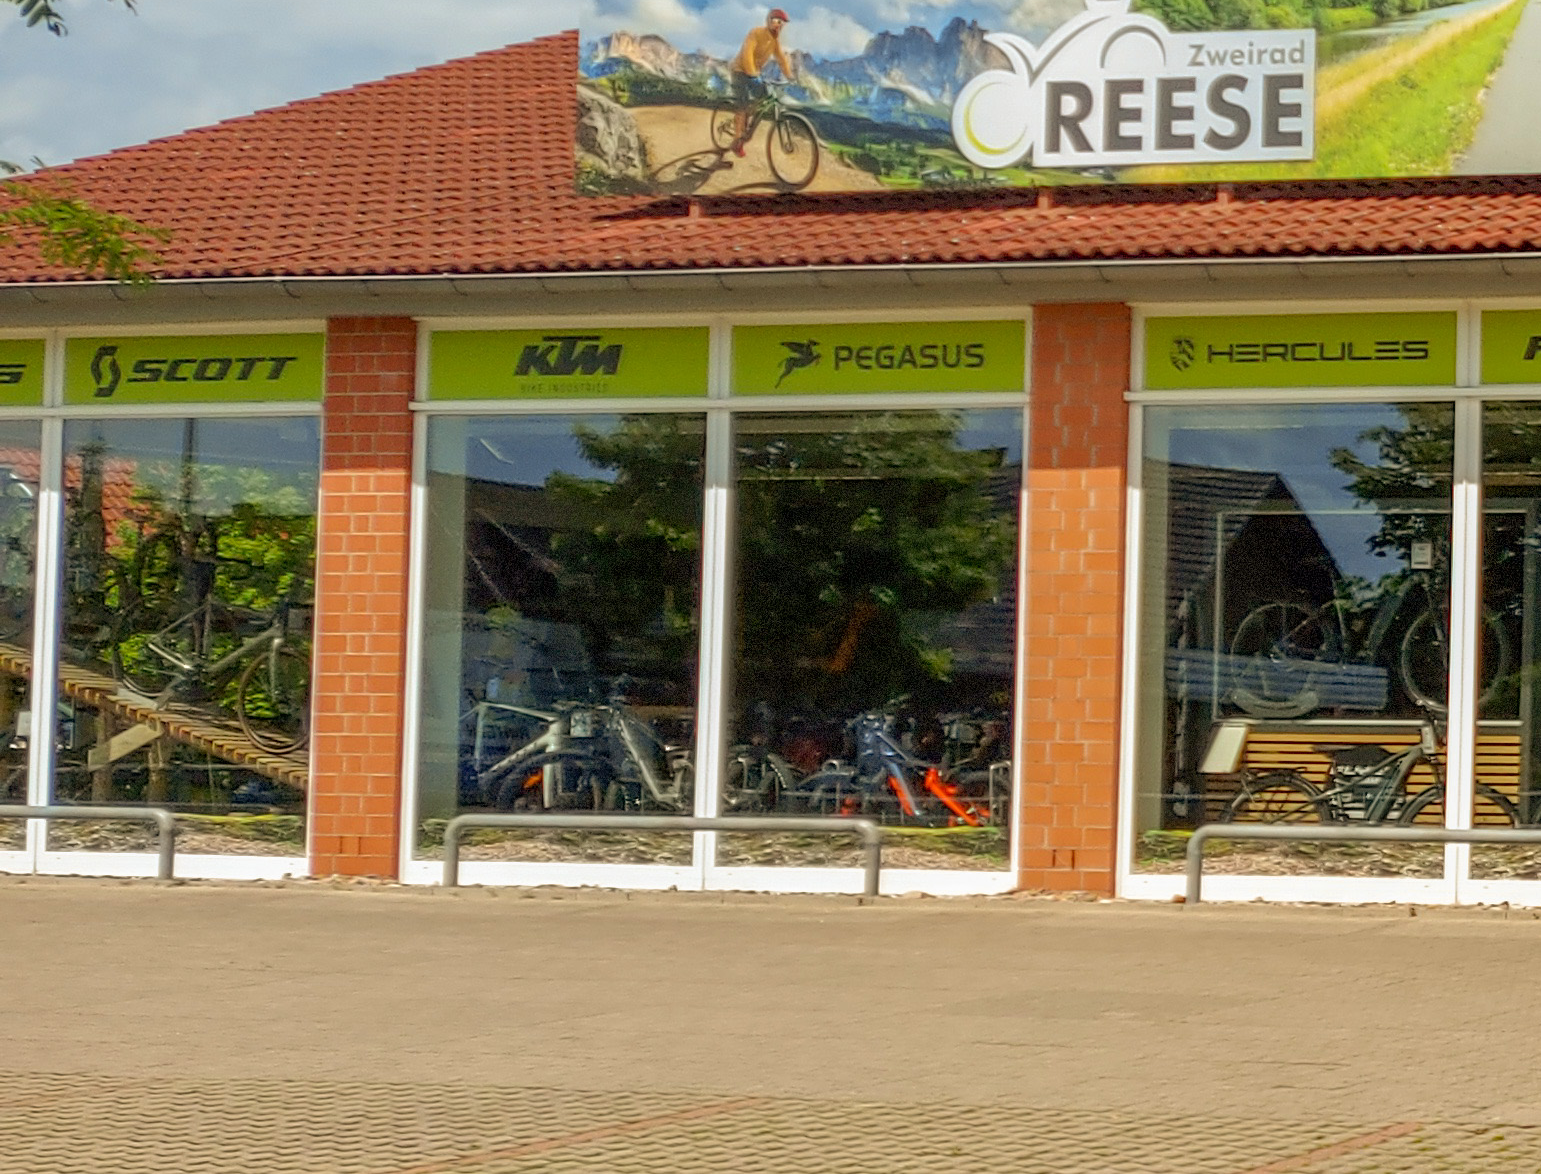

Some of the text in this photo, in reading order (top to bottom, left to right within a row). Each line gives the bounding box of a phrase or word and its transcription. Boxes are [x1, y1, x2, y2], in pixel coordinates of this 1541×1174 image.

[1187, 39, 1305, 67] Zweirad
[1044, 73, 1305, 154] REESE
[514, 335, 623, 376] KTM
[834, 343, 985, 370] PEGASUS
[1207, 341, 1429, 363] HERCULES
[127, 356, 298, 383] SCOTT
